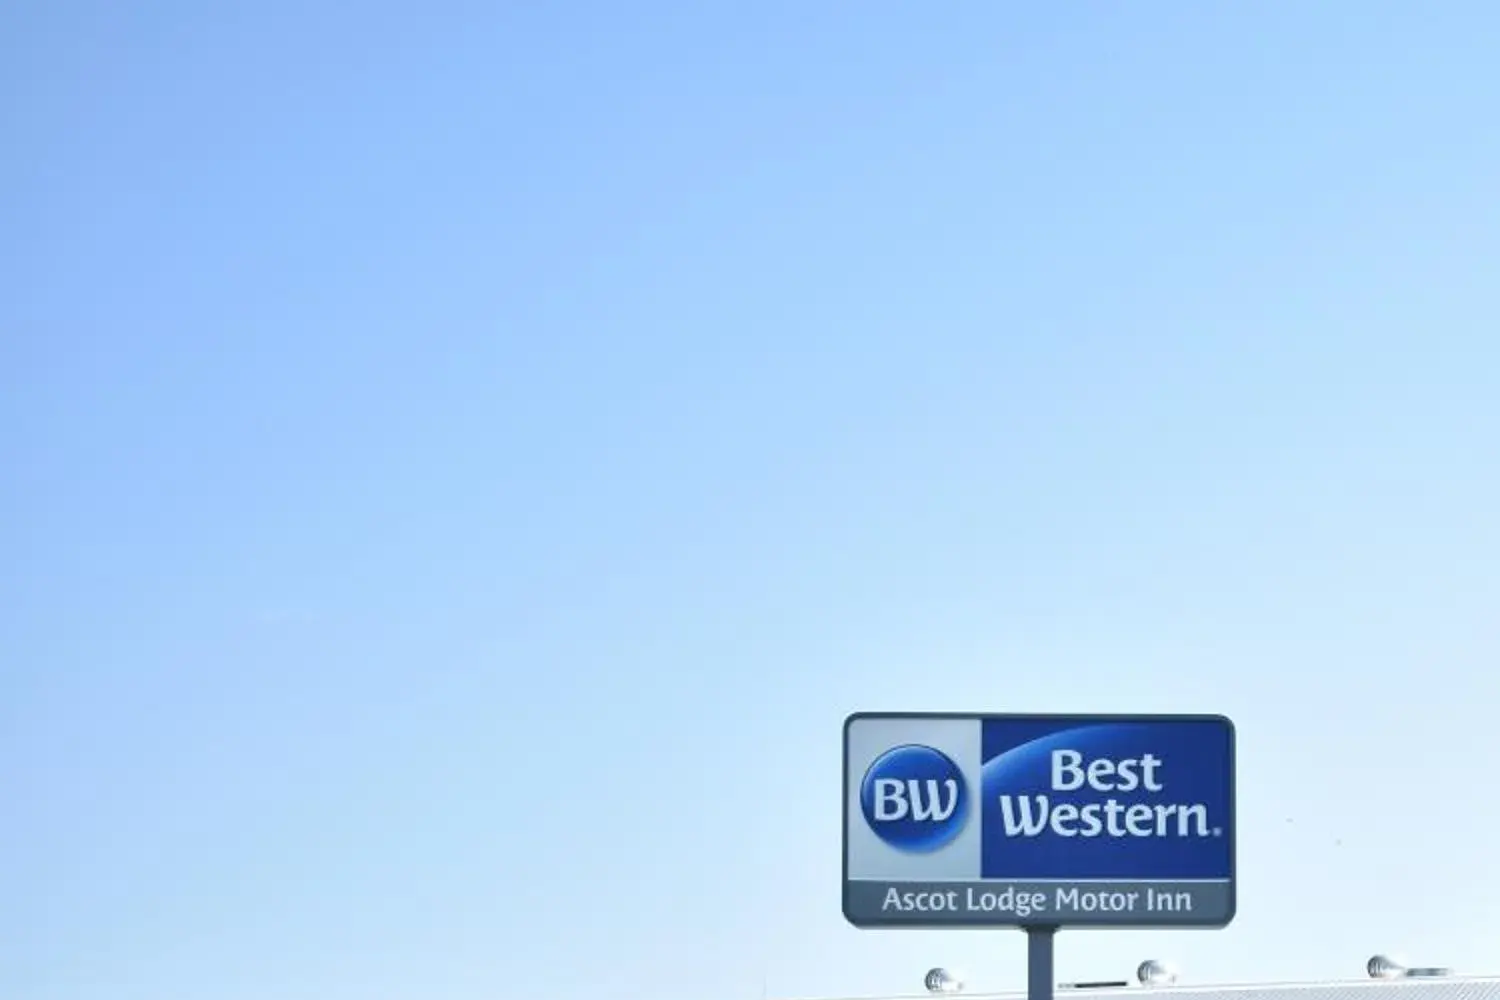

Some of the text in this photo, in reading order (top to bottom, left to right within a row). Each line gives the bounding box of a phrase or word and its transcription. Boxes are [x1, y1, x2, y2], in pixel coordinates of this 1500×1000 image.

[1051, 749, 1163, 792] Best
[873, 778, 959, 822] BW
[882, 887, 1192, 916] Ascot Lodge Motor Inn
